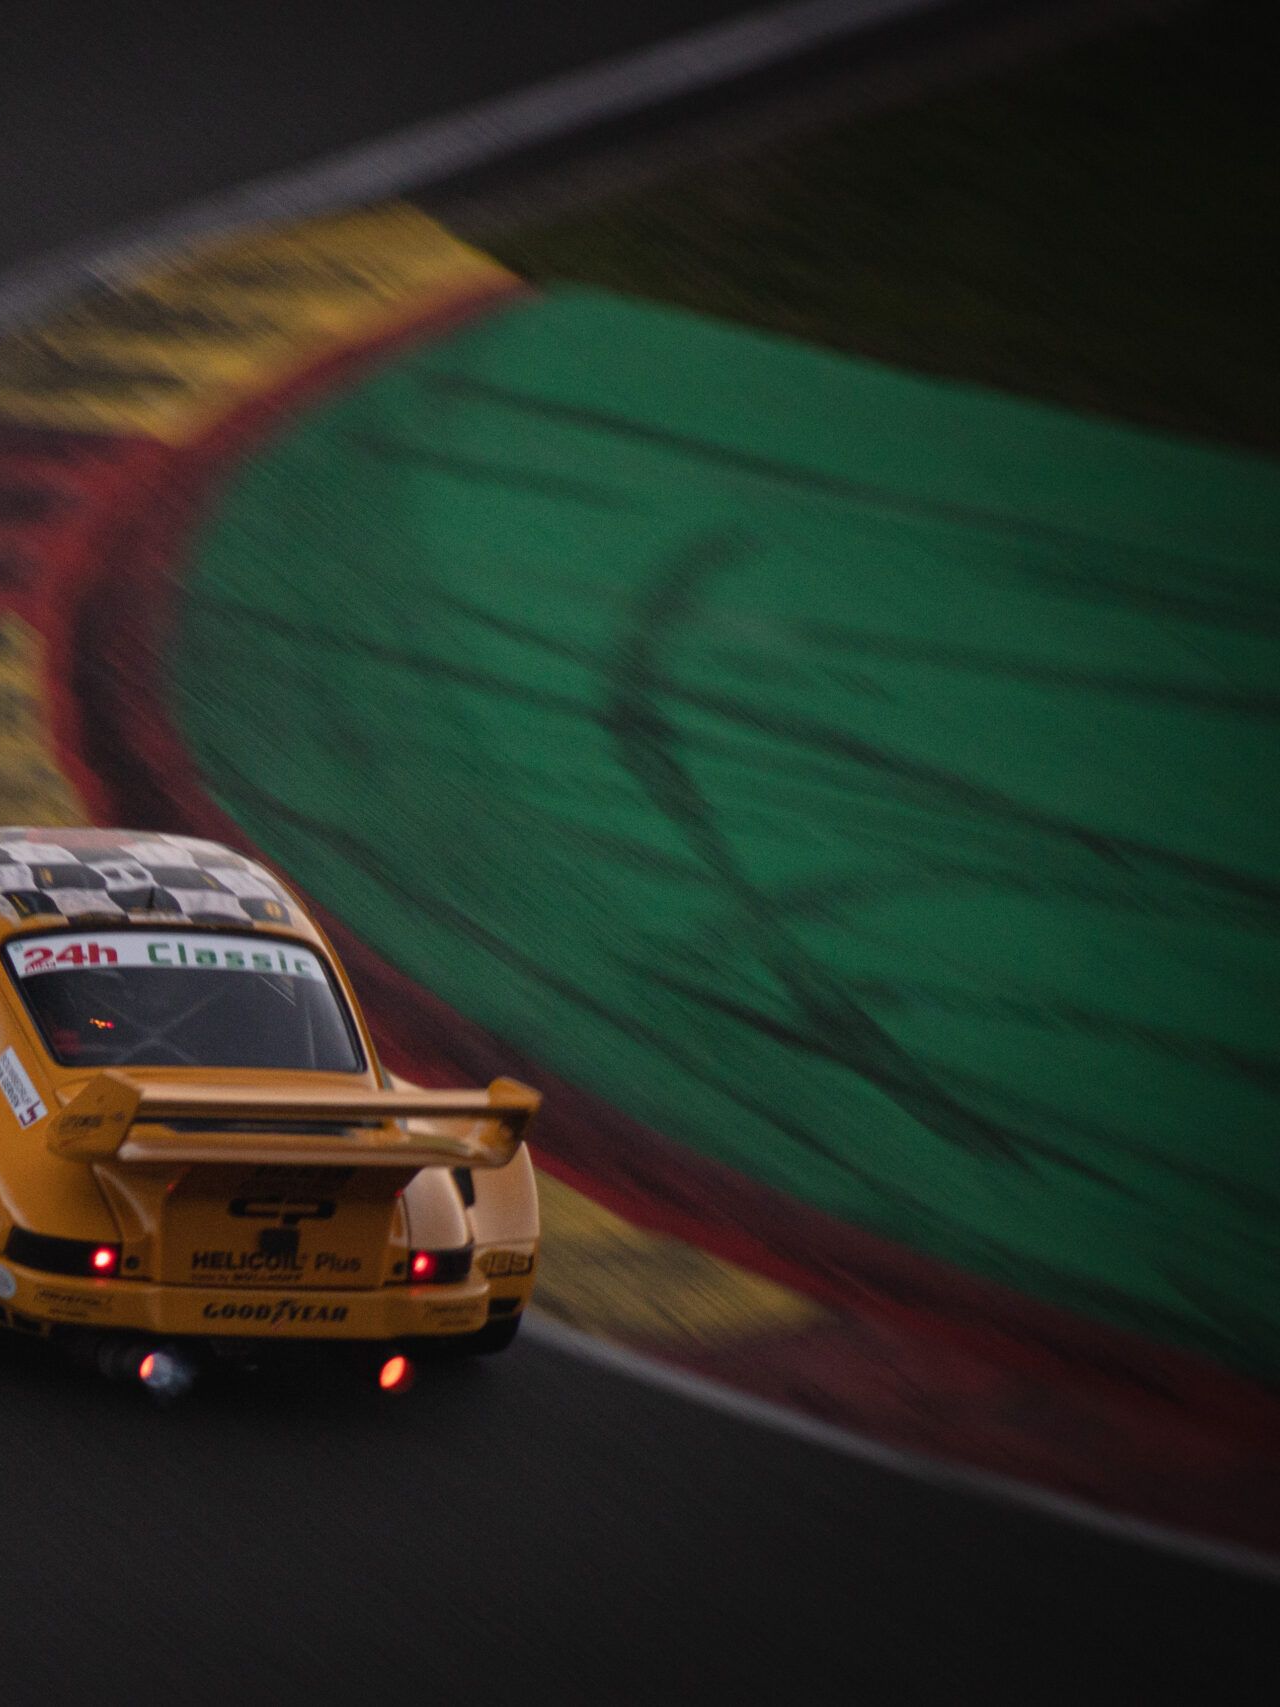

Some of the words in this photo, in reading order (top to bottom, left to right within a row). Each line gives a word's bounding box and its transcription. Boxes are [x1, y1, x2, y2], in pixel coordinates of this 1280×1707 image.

[23, 942, 118, 972] 24h
[147, 942, 312, 976] Classic
[191, 1250, 303, 1271] HELICOIL
[314, 1252, 362, 1273] Plus
[203, 1299, 347, 1324] GOODYEAR
